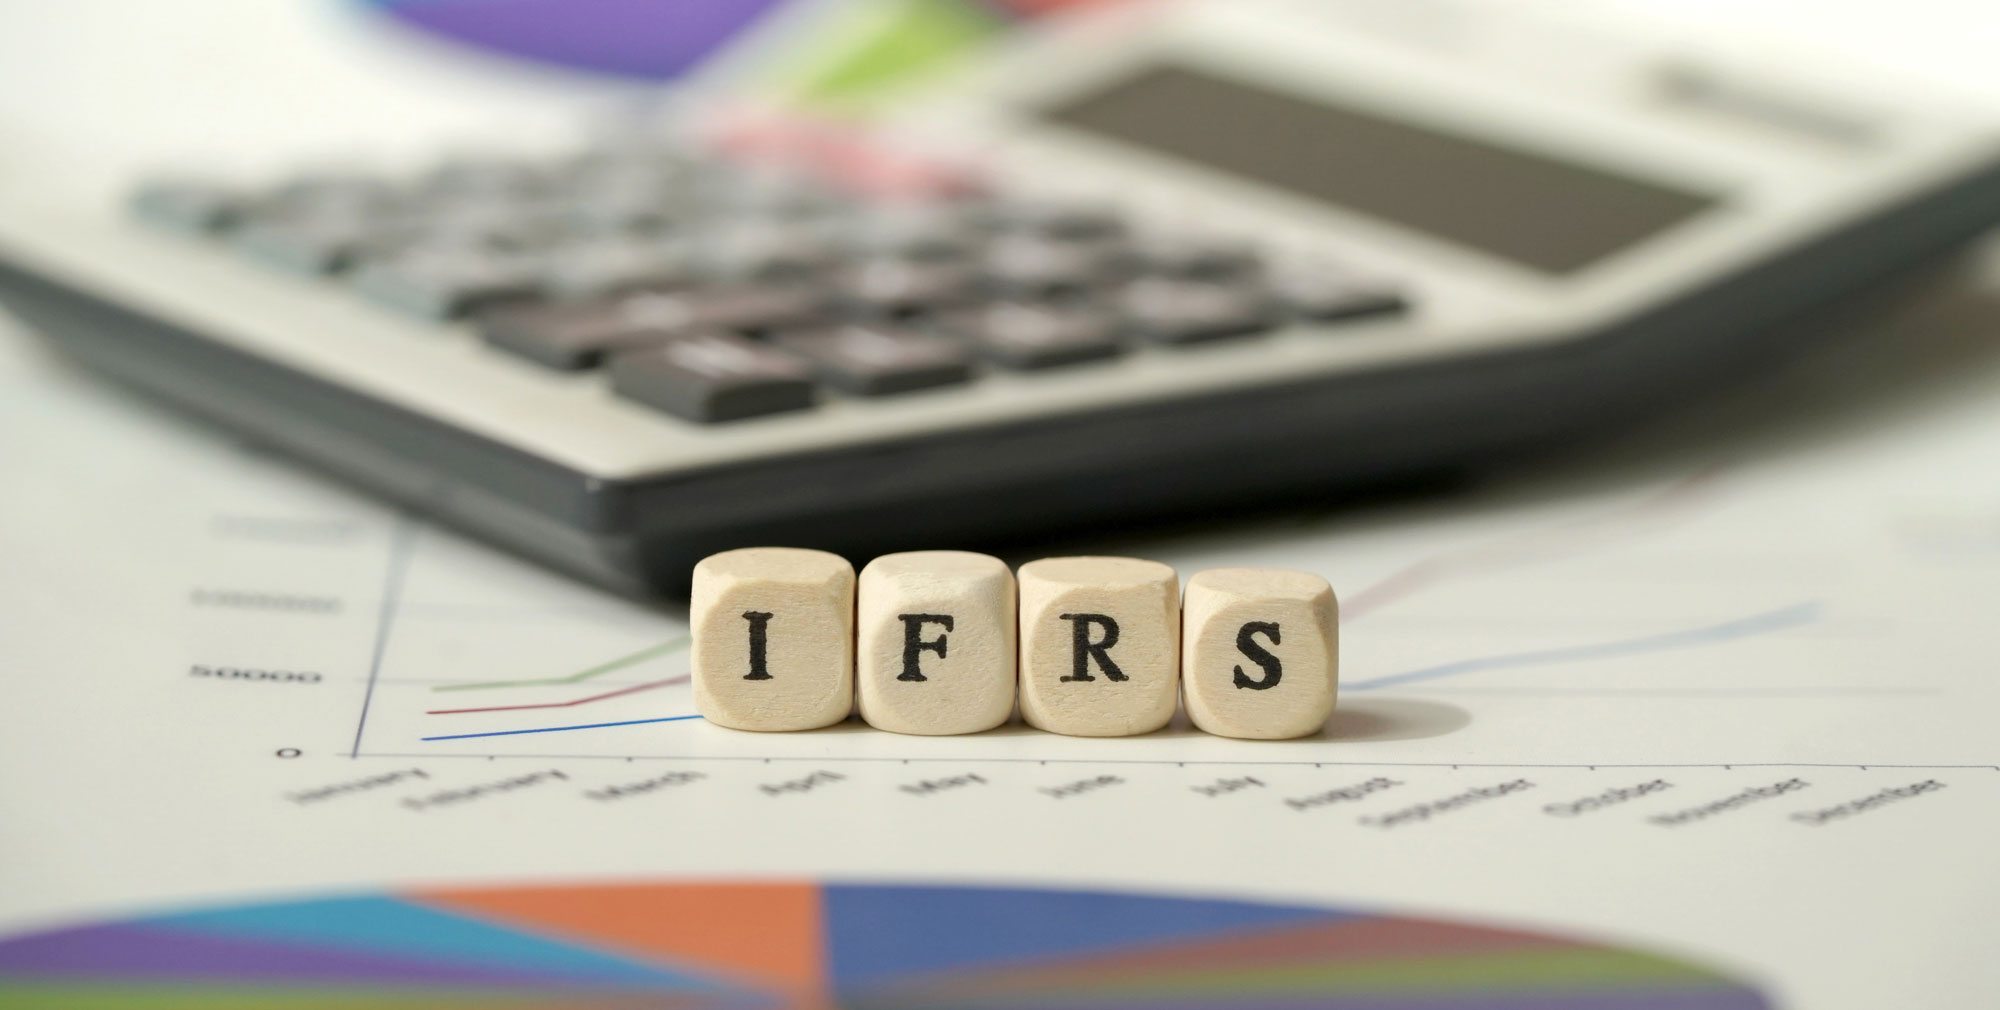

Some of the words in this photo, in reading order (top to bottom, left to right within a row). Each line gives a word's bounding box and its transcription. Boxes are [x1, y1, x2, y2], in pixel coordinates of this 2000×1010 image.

[189, 664, 323, 684] 50000
[274, 747, 304, 759] 0
[896, 772, 988, 797] May
[1283, 776, 1405, 813] August
[1541, 778, 1676, 819] October
[1788, 777, 1949, 827] December
